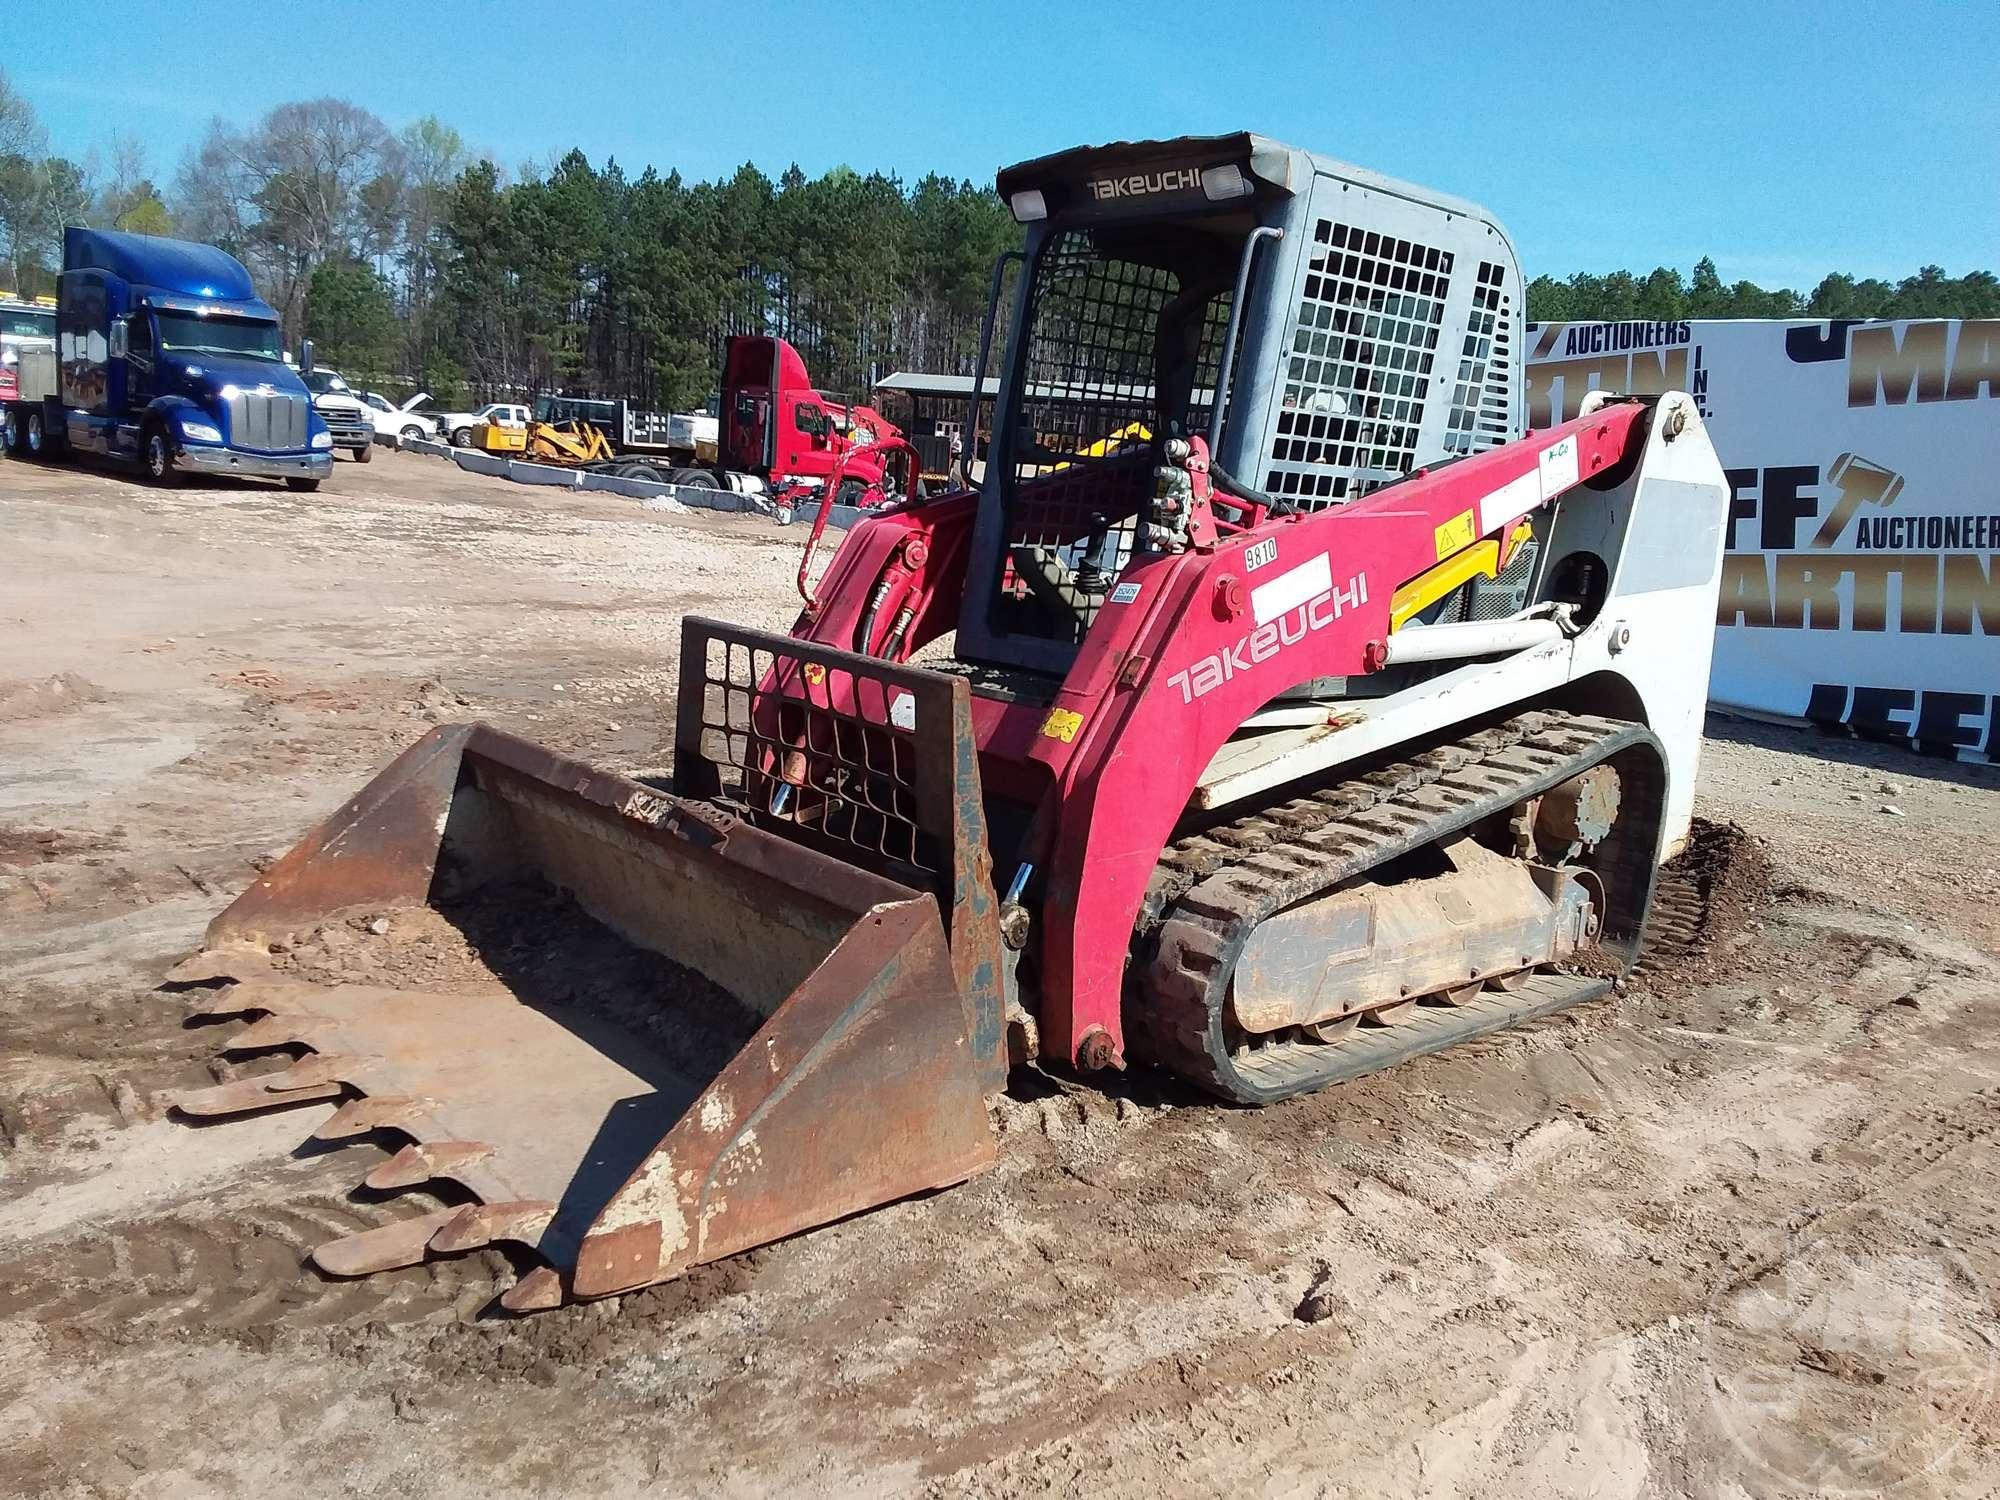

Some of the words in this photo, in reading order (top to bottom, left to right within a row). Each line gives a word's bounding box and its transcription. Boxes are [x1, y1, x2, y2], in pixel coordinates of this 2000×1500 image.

[1566, 320, 1691, 355] AUCTIONEERS
[1856, 515, 2000, 549] AUCTIONEER
[1246, 539, 1275, 569] 9810
[1716, 553, 2000, 636] ARTIN
